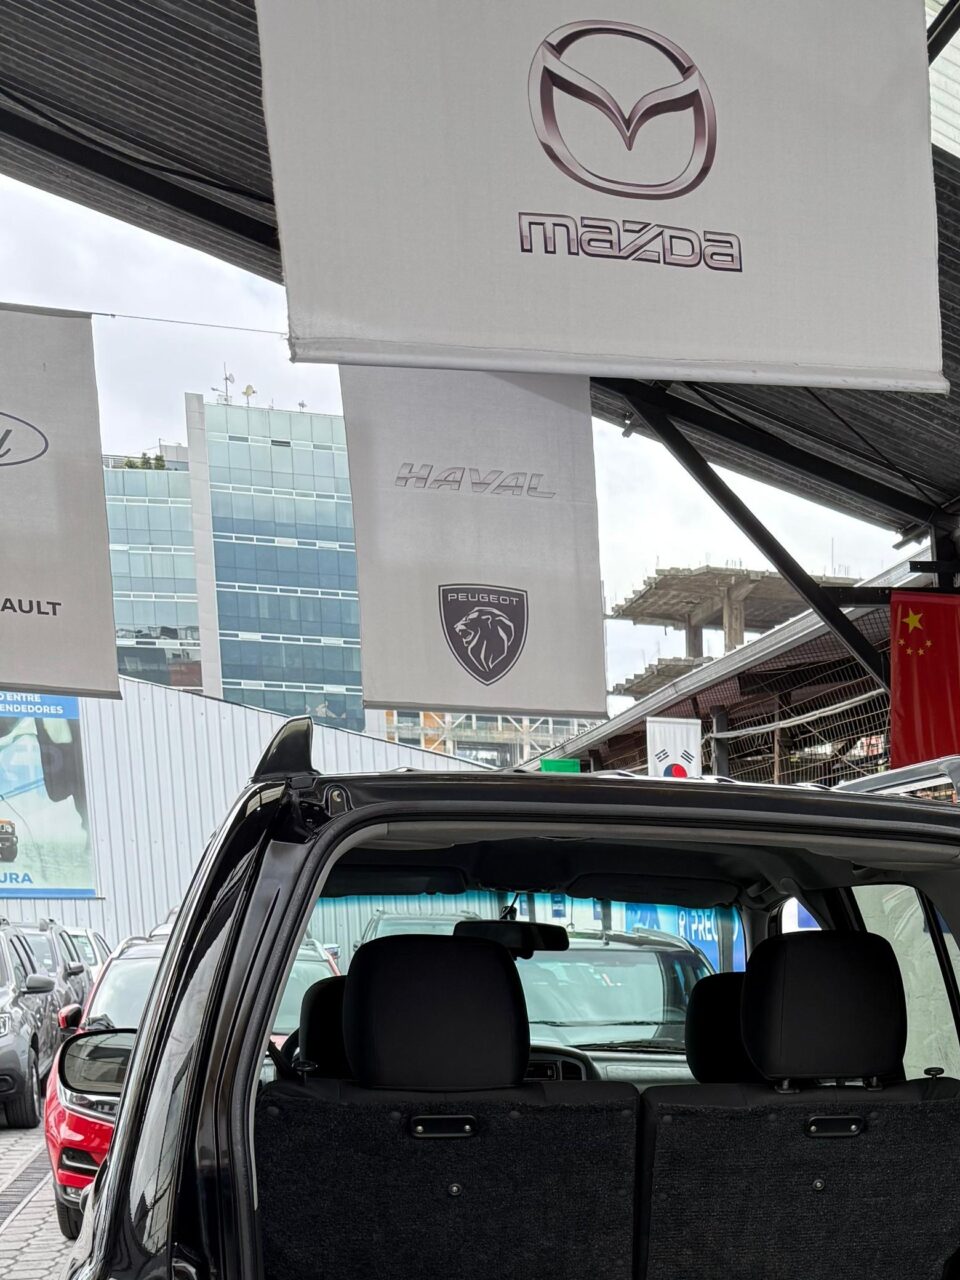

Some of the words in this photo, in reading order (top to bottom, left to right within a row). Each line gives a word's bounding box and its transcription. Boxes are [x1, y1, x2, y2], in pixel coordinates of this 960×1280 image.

[395, 462, 557, 499] HAVAL
[447, 593, 519, 606] PEUGEOT
[6, 692, 41, 703] ENTRE
